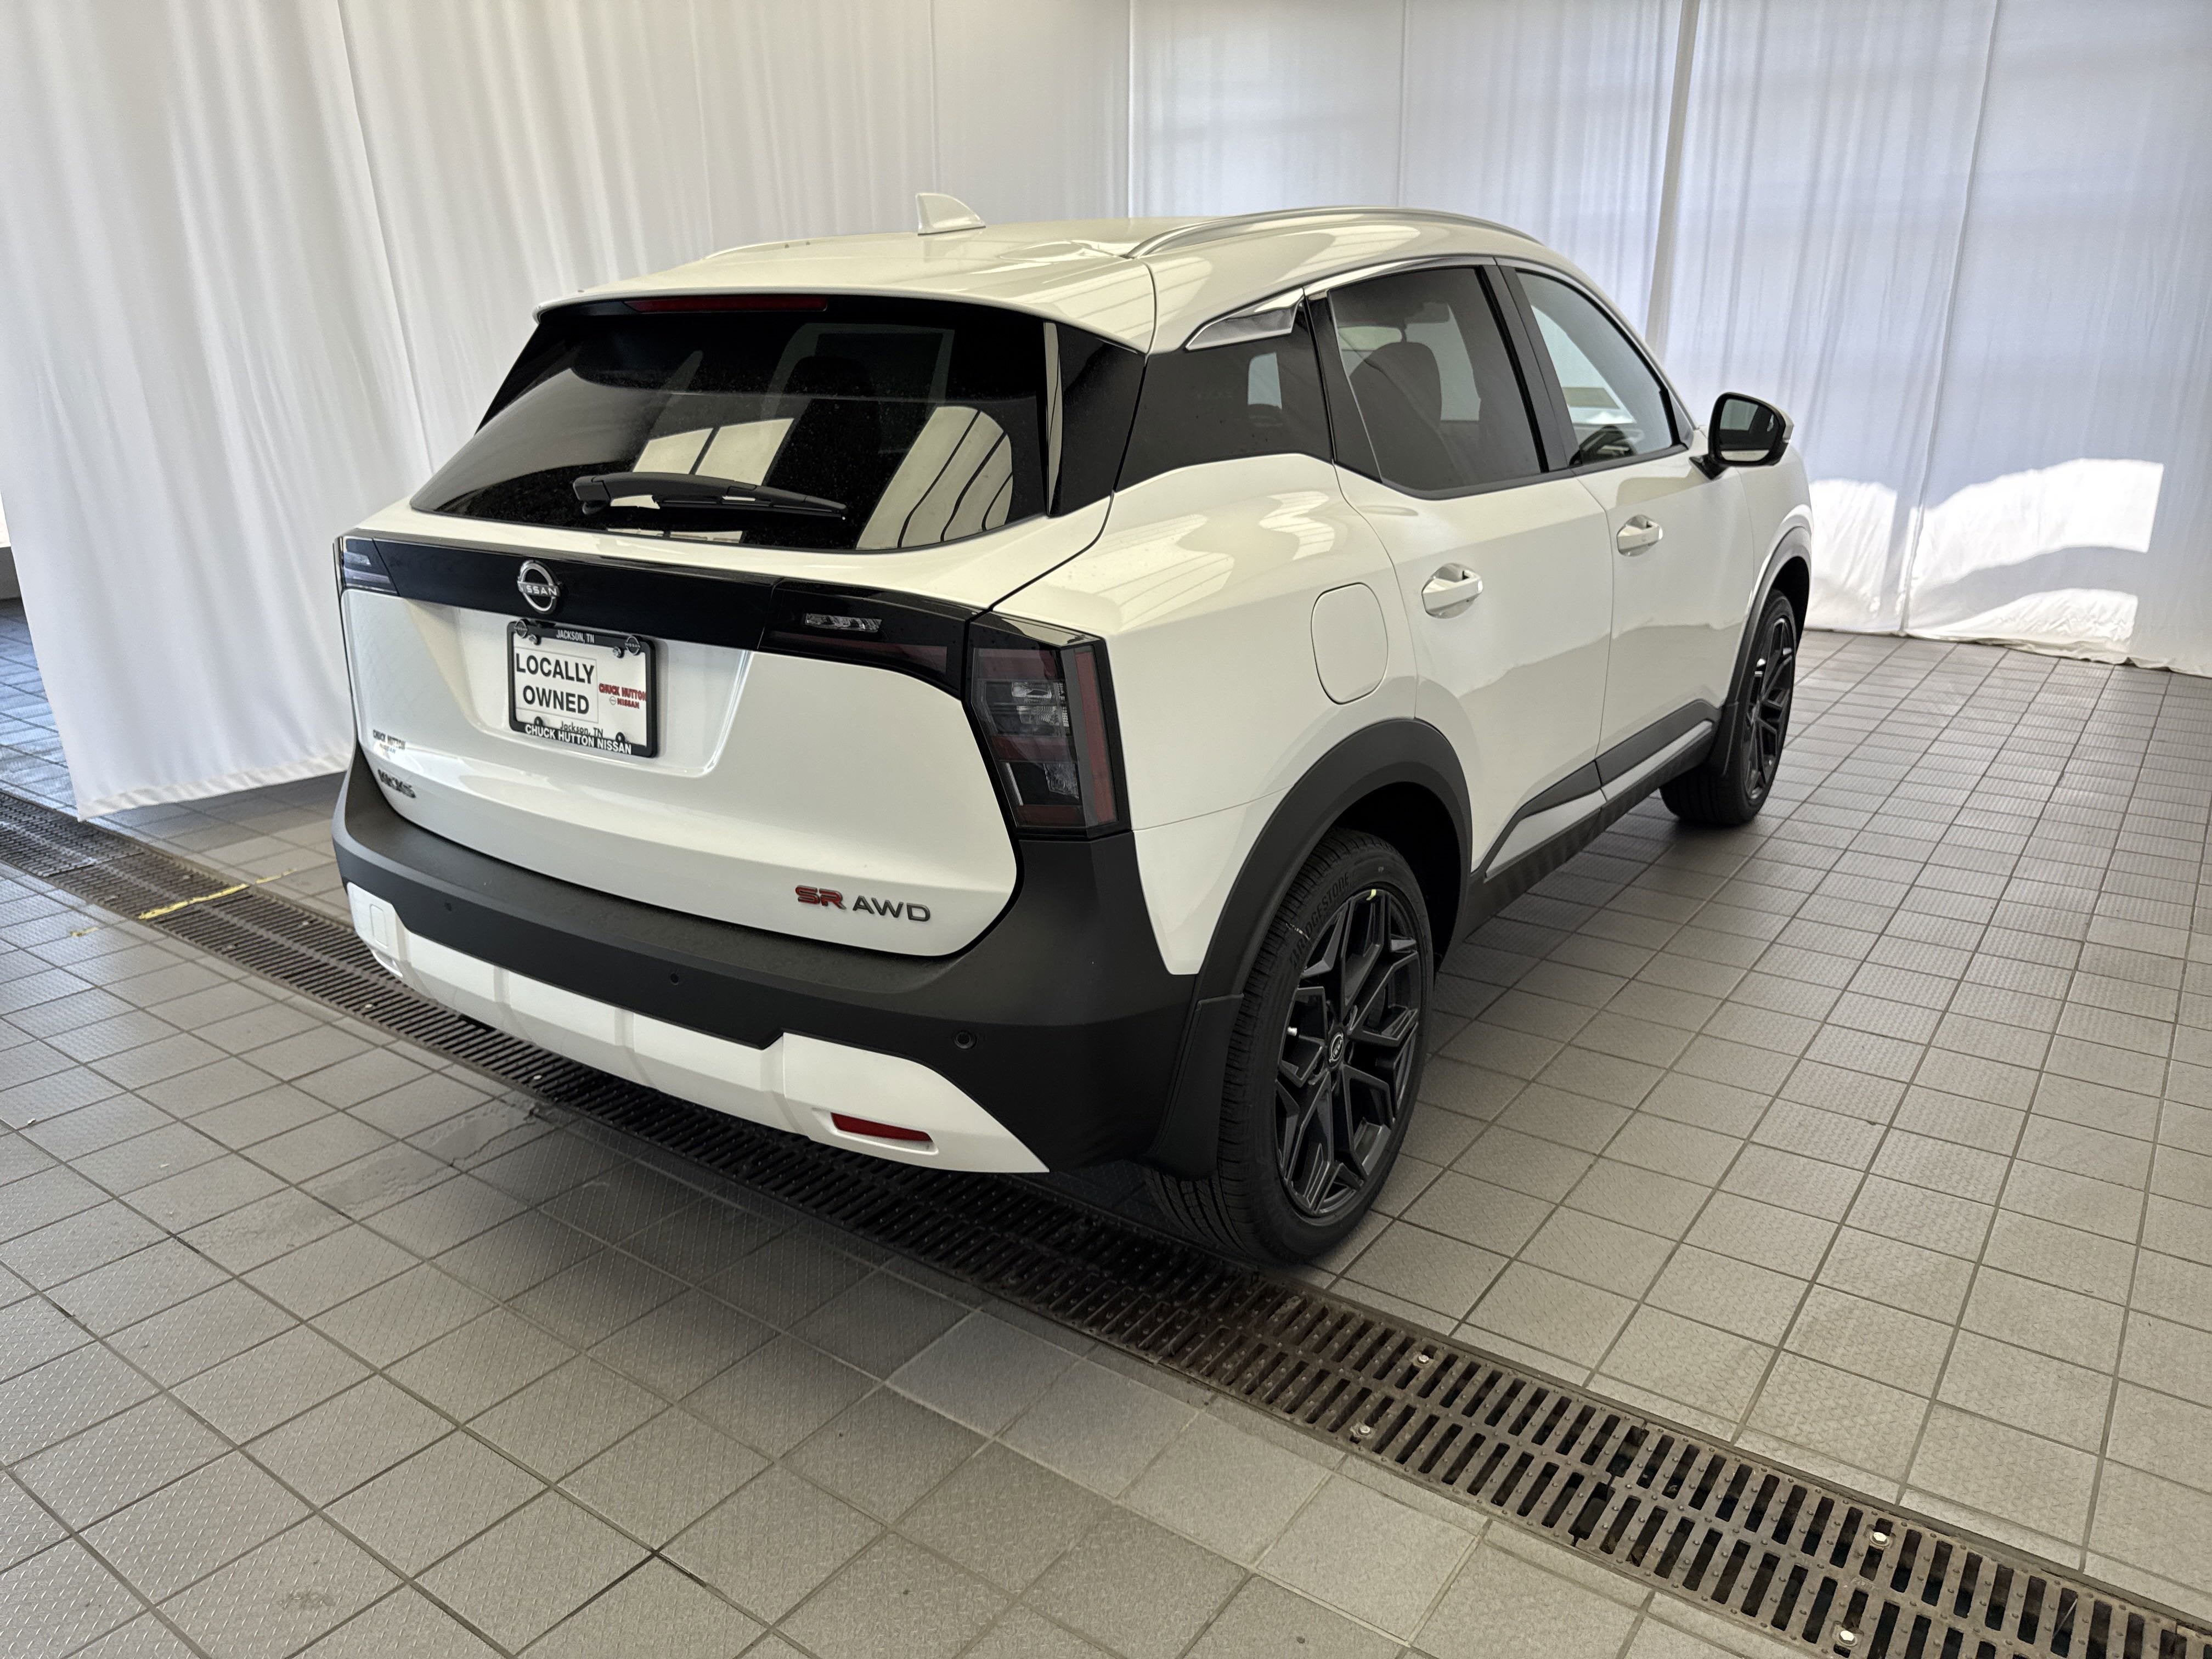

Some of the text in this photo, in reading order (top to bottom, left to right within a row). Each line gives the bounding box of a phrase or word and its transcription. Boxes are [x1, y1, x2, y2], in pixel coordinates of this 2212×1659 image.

[556, 629, 595, 644] JACKSON, TN
[516, 653, 595, 684] LOCALLY
[523, 685, 590, 714] OWNED
[599, 683, 646, 701] CHUCK HUTTON
[617, 698, 640, 709] NISSAN
[525, 724, 631, 754] CHUCK HUTTON NISSAN
[560, 721, 603, 738] Jackson, TN
[795, 885, 930, 922] SR AWD
